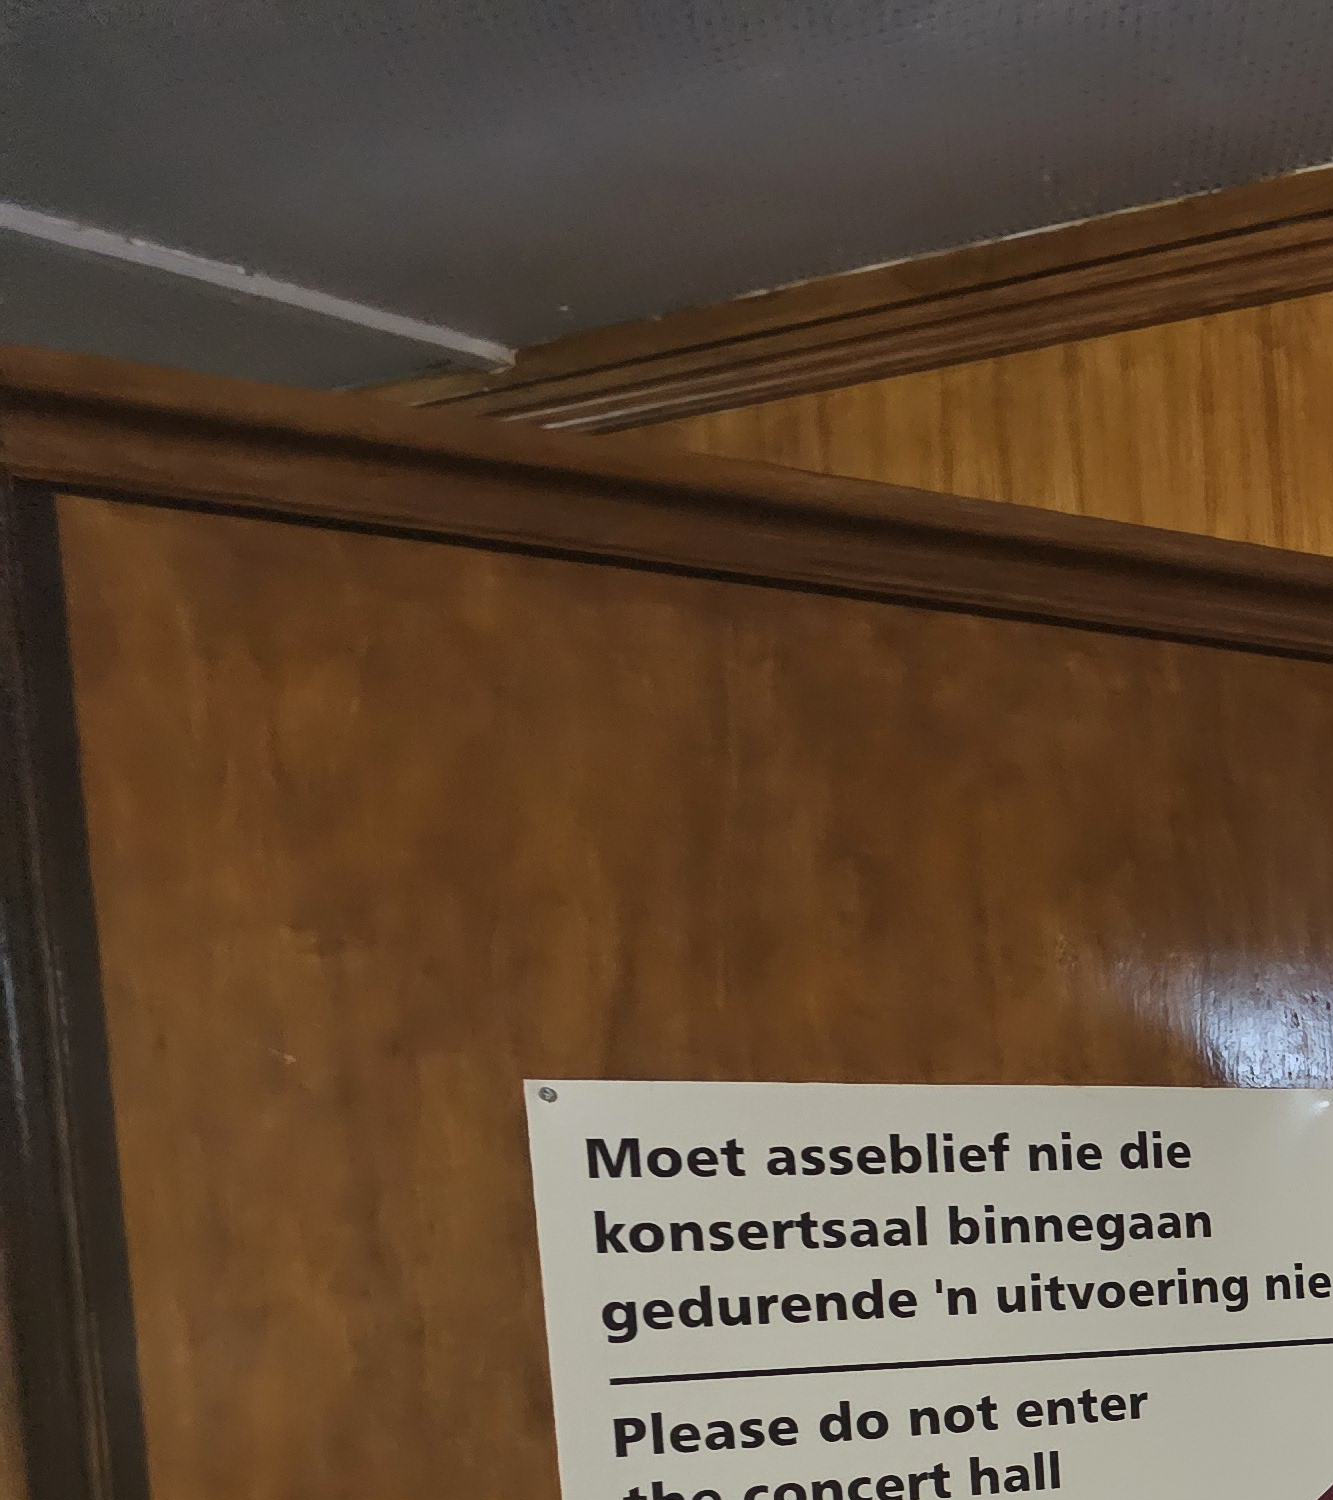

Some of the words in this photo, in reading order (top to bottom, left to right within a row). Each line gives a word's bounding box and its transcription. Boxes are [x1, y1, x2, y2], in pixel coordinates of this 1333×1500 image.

[585, 1137, 746, 1179] Moet
[767, 1131, 1010, 1176] asseblief
[1028, 1131, 1103, 1172] nie
[1120, 1130, 1192, 1170] die
[593, 1205, 928, 1254] konsertsaal
[948, 1204, 1212, 1252] binnegaan
[601, 1278, 918, 1344] gedurende
[935, 1278, 977, 1316] 'n
[996, 1267, 1249, 1314] uitvoering
[613, 1411, 799, 1458] Please
[819, 1400, 889, 1443] do
[909, 1395, 999, 1437] not
[1016, 1388, 1149, 1428] enter
[969, 1450, 1061, 1496] hall
